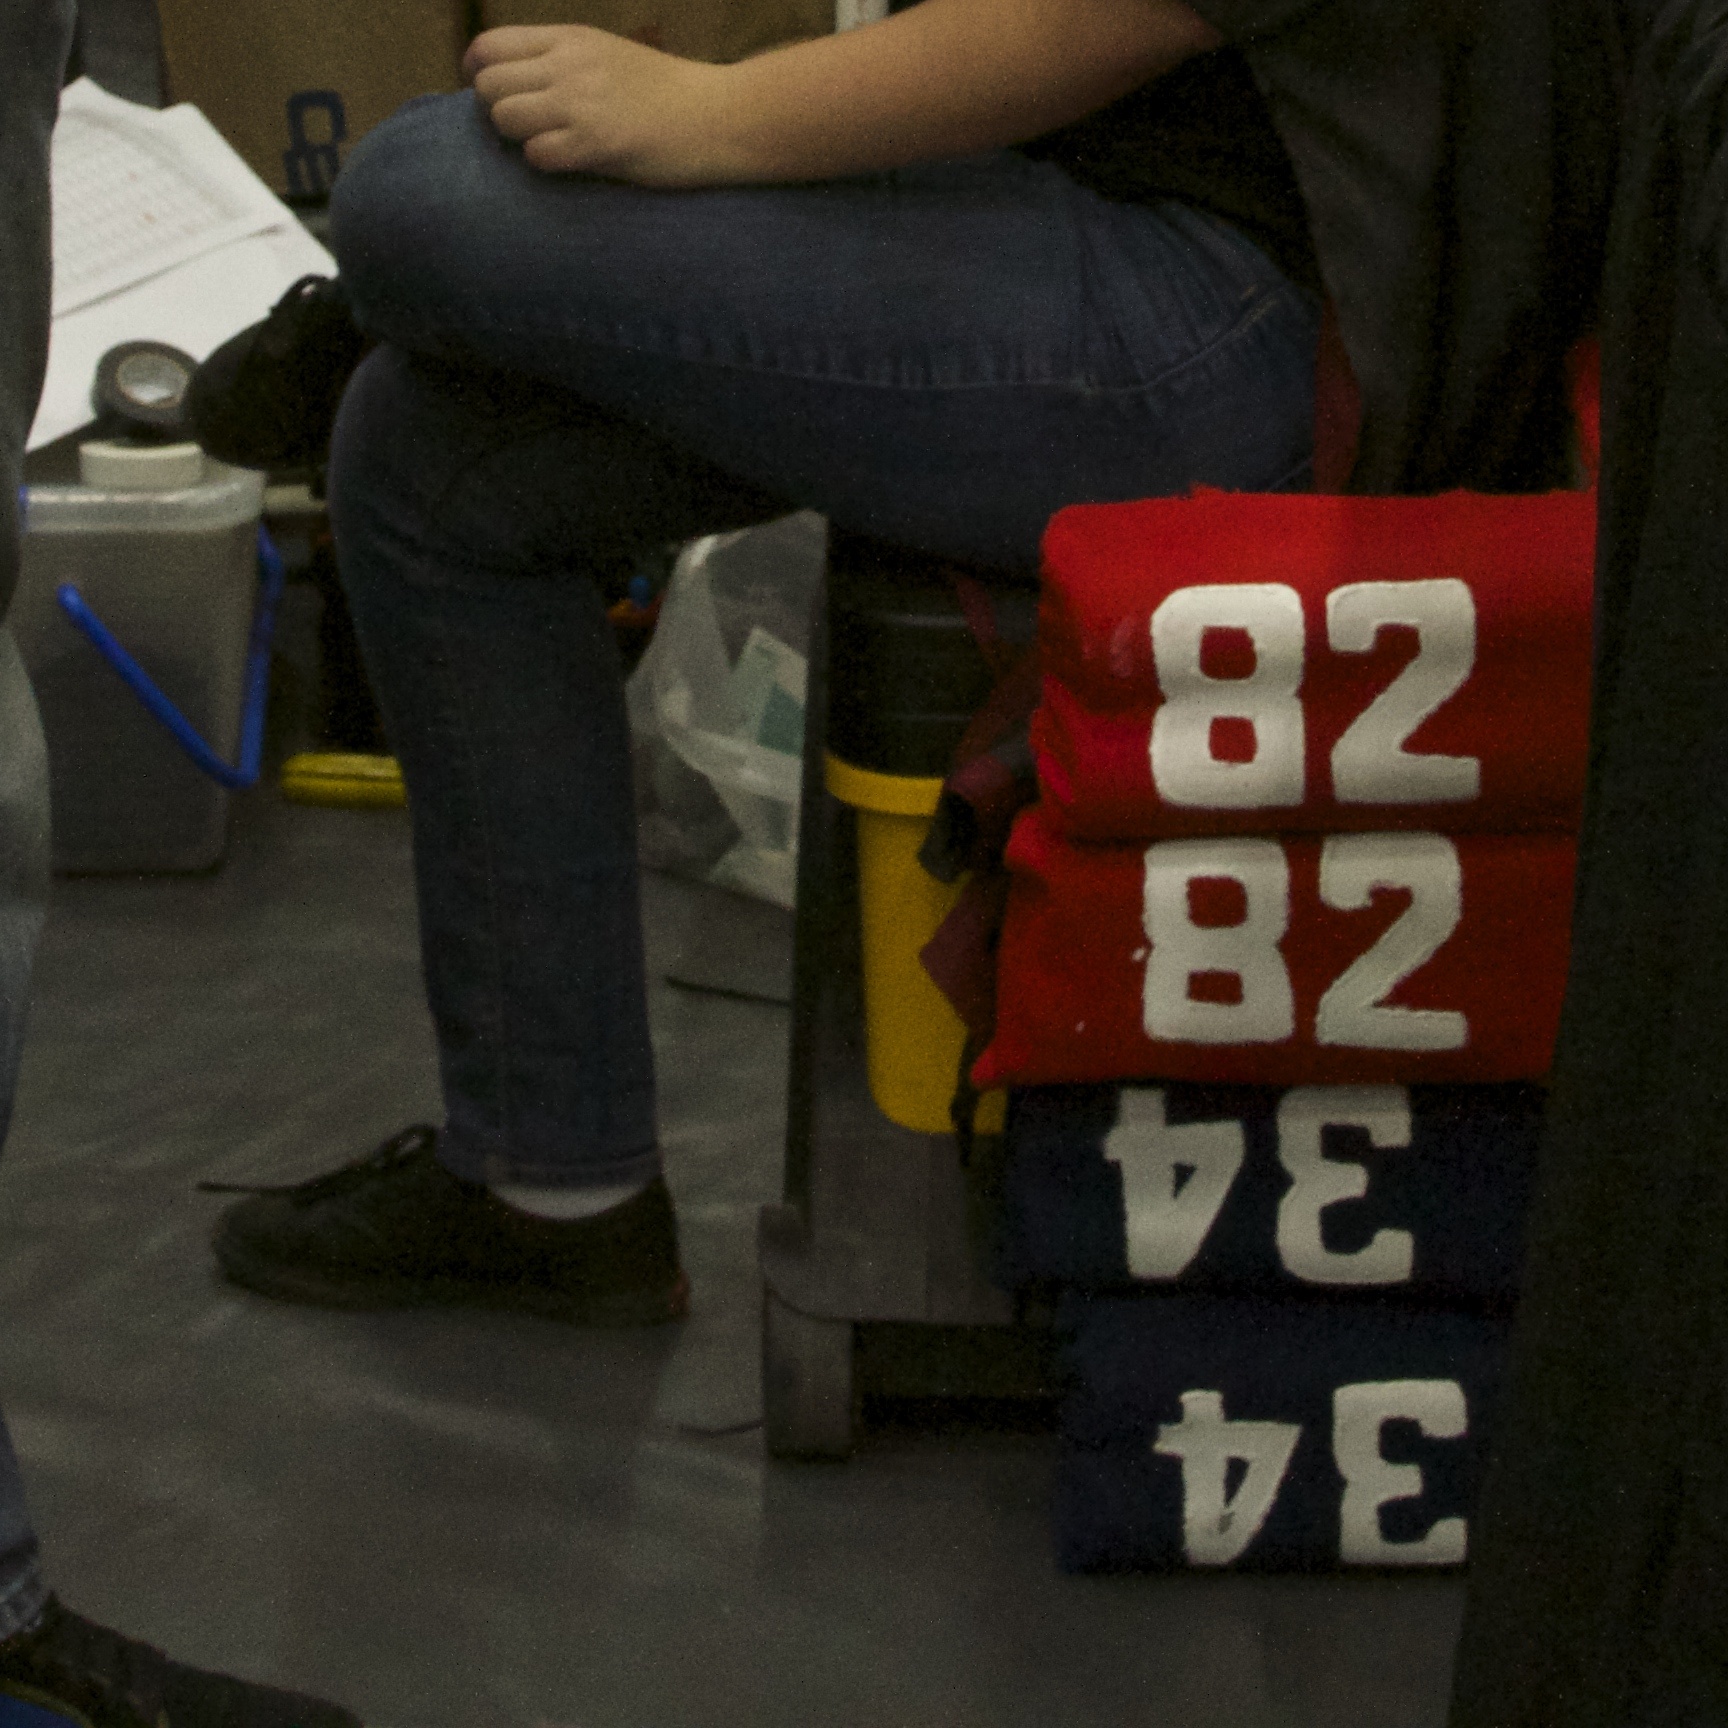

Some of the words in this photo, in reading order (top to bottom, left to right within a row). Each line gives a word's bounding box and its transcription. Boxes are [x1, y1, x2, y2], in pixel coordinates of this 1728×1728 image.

[1150, 578, 1481, 810] 82
[1142, 831, 1468, 1051] 82
[1103, 1085, 1415, 1285] 34
[1153, 1377, 1469, 1565] 34
